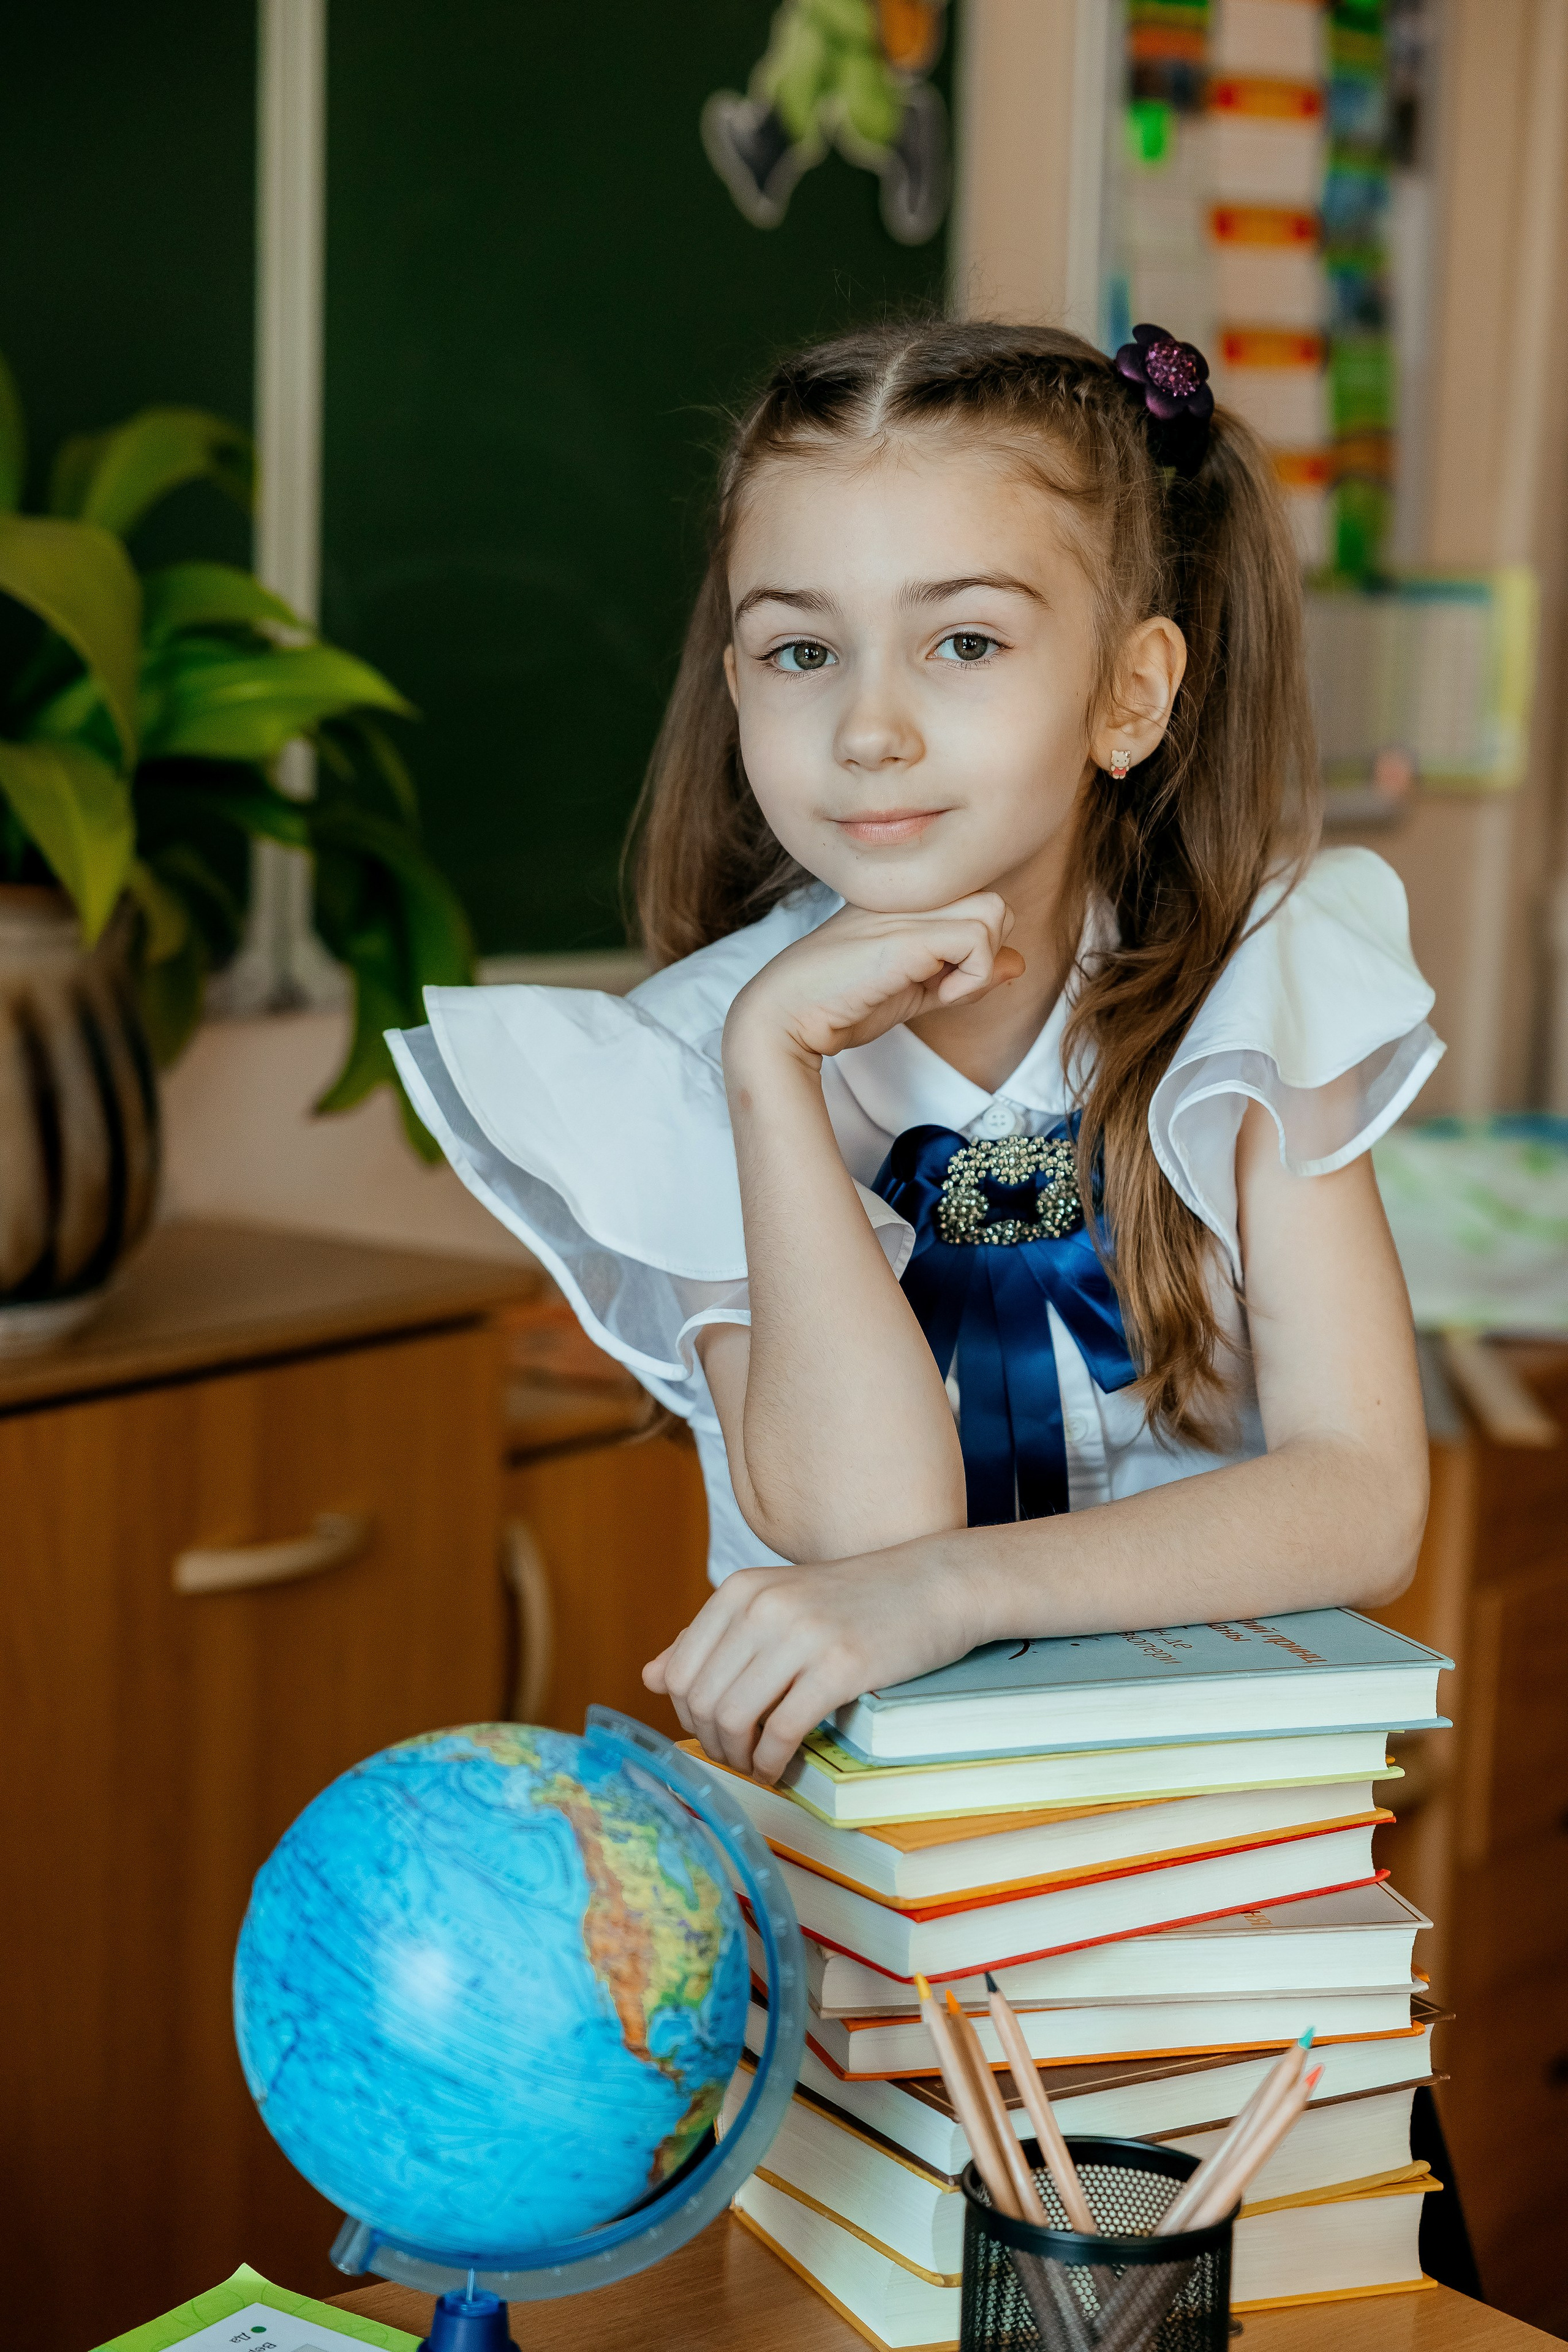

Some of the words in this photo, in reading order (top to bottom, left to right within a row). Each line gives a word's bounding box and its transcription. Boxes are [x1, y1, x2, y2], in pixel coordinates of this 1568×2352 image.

[1205, 1623, 1253, 1642] аны
[1156, 1638, 1193, 1649] де
[1261, 1634, 1329, 1664] принц
